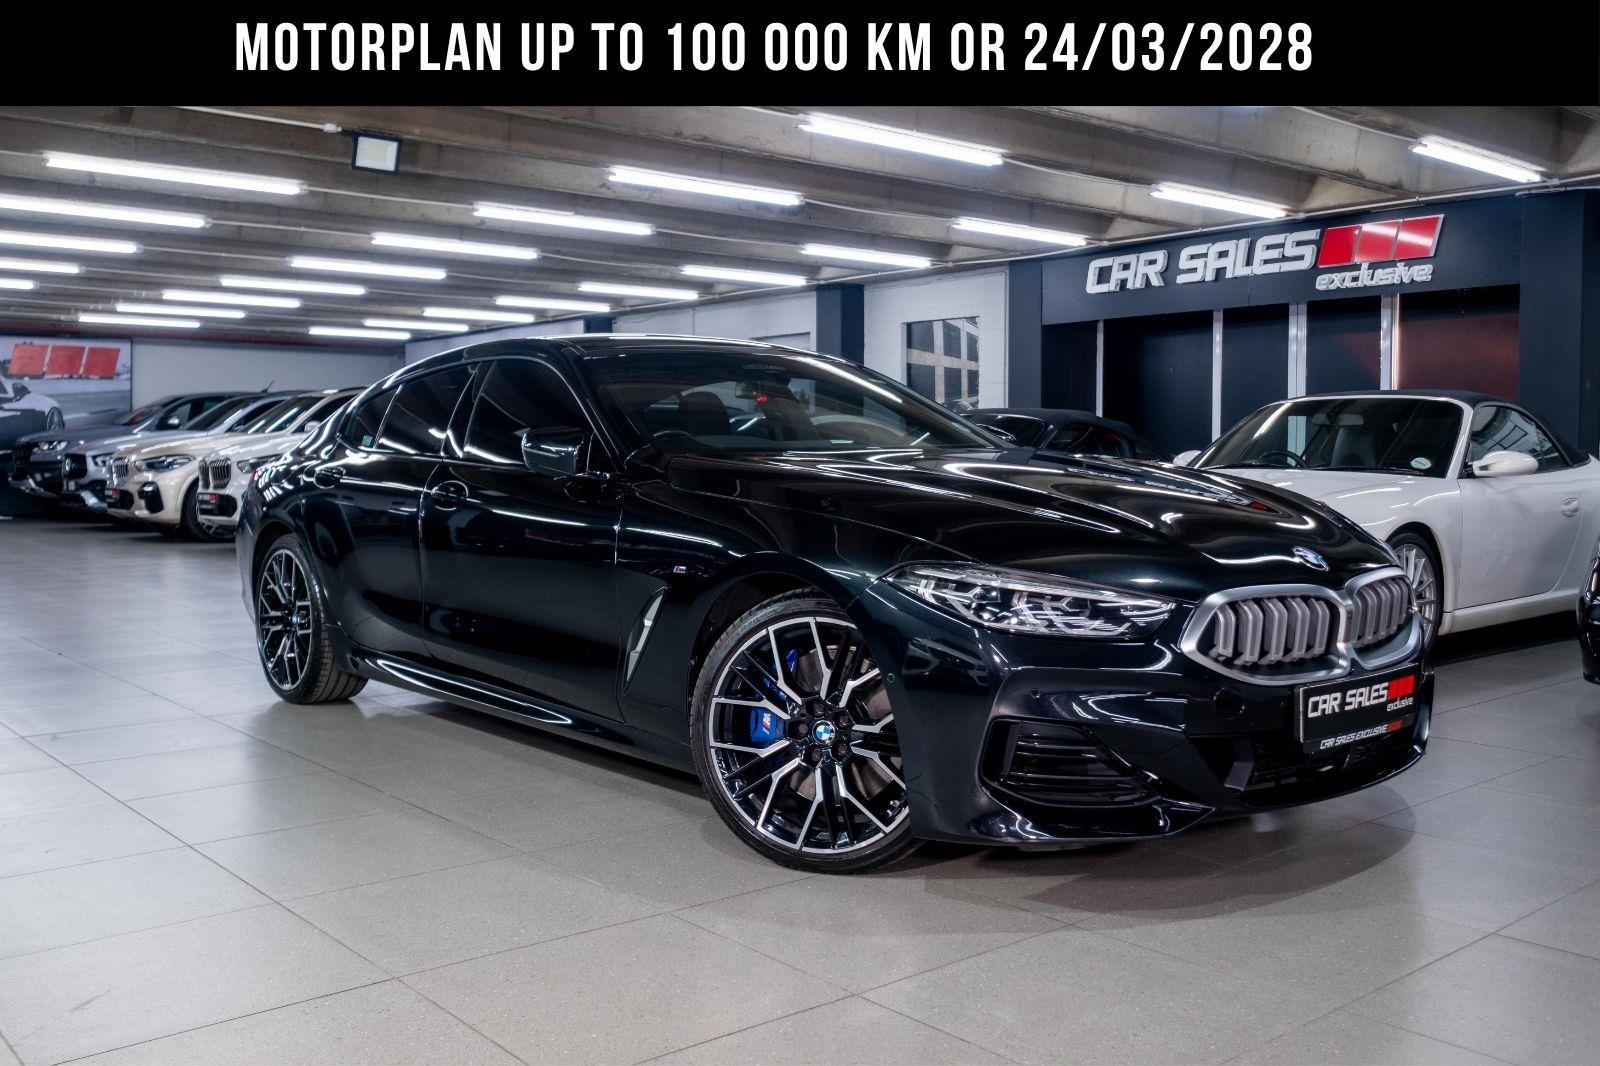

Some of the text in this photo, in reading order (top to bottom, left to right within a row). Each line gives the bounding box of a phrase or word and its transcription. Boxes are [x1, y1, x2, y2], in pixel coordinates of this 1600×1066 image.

[1086, 229, 1321, 294] CAR SALES
[1315, 262, 1434, 291] exclusive
[1307, 682, 1389, 718] CAR SALES
[1386, 696, 1413, 712] exclusive
[1320, 724, 1389, 750] CAR SALES EXCLUSIVE
